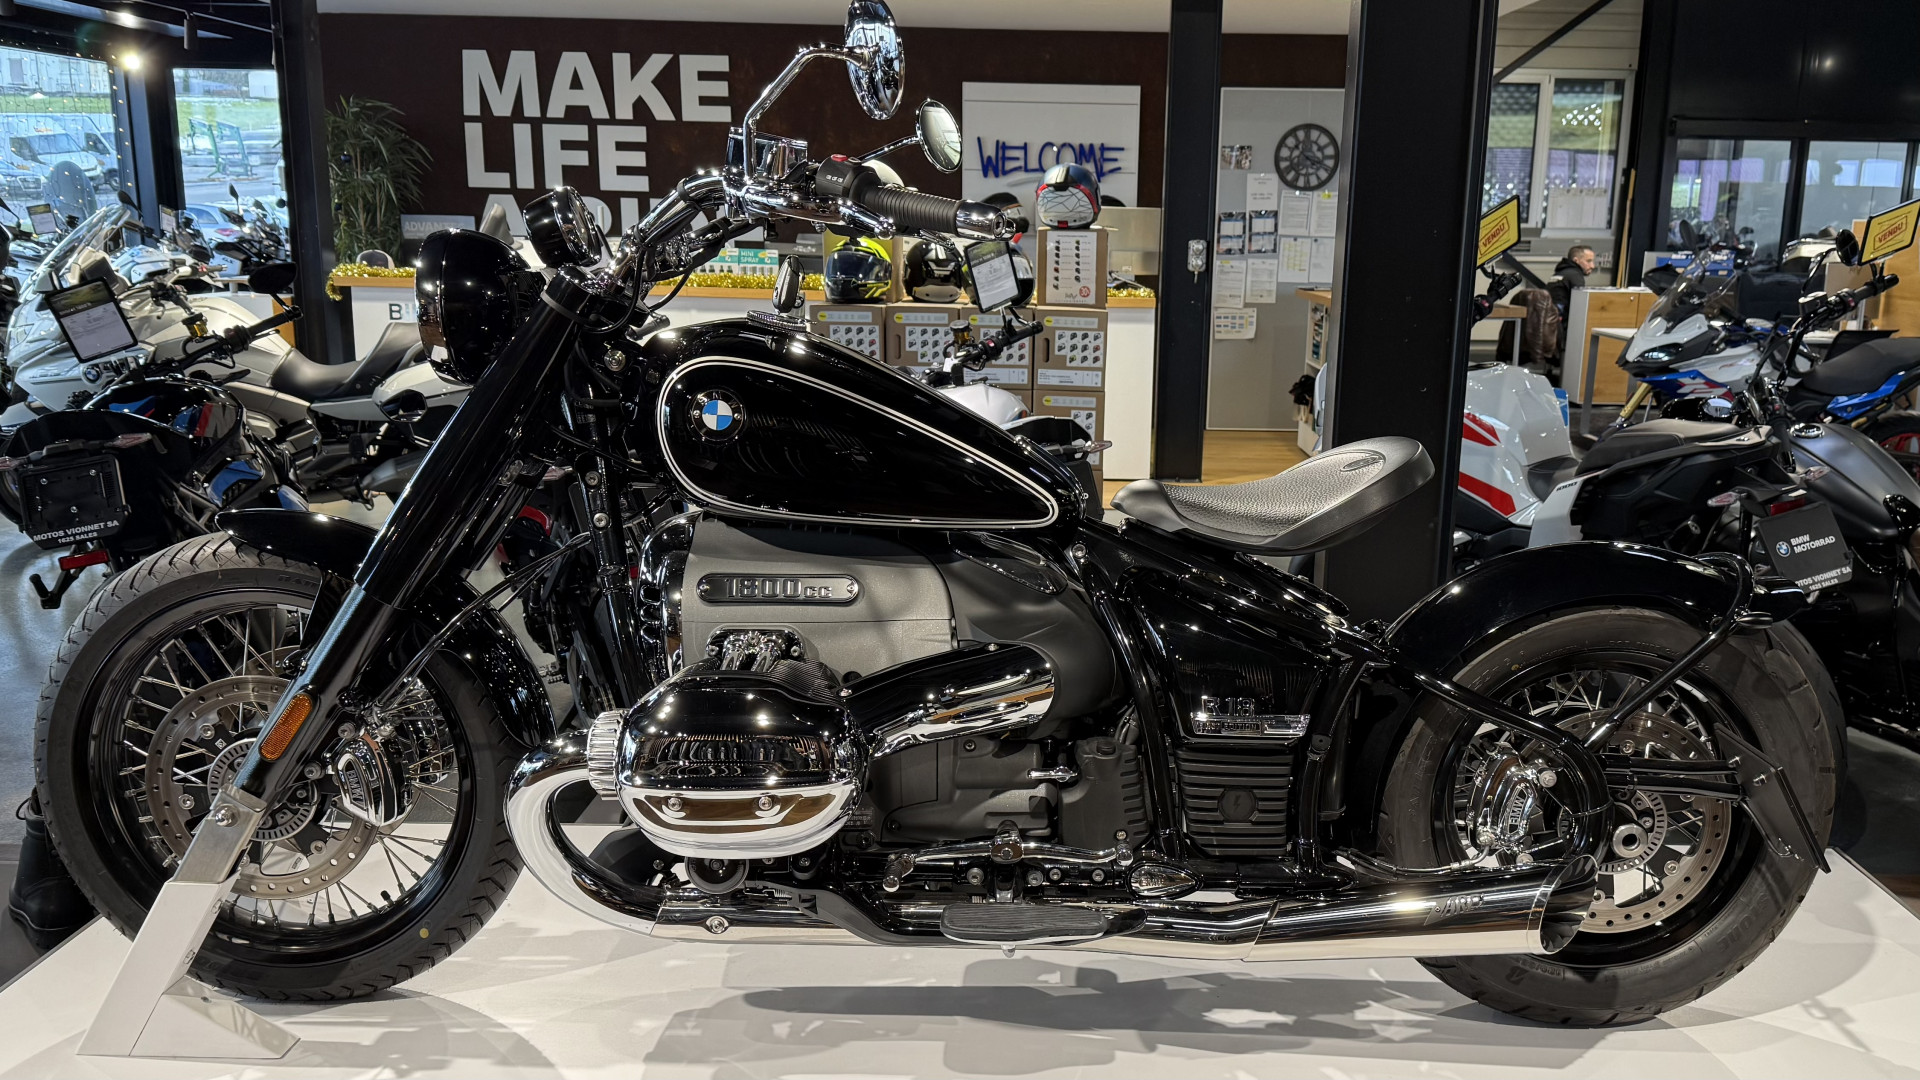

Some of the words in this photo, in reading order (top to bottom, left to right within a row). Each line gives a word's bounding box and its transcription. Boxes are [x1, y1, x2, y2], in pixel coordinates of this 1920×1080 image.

[462, 49, 731, 122] MAKE
[464, 122, 650, 192] LIFE
[977, 136, 1125, 182] WELCOME
[1482, 222, 1505, 248] VENDU
[1878, 221, 1904, 243] VENDU
[33, 530, 64, 541] MOTOS
[66, 521, 104, 534] VIONNET
[106, 519, 119, 527] SA
[75, 531, 97, 540] SALES
[1790, 534, 1810, 545] BMW
[1793, 535, 1836, 553] MOTORRAD
[1812, 568, 1840, 580] VIONNET
[1841, 565, 1851, 573] SA
[1821, 578, 1838, 587] SALES
[346, 769, 364, 802] BMW
[1509, 794, 1526, 825] BMW
